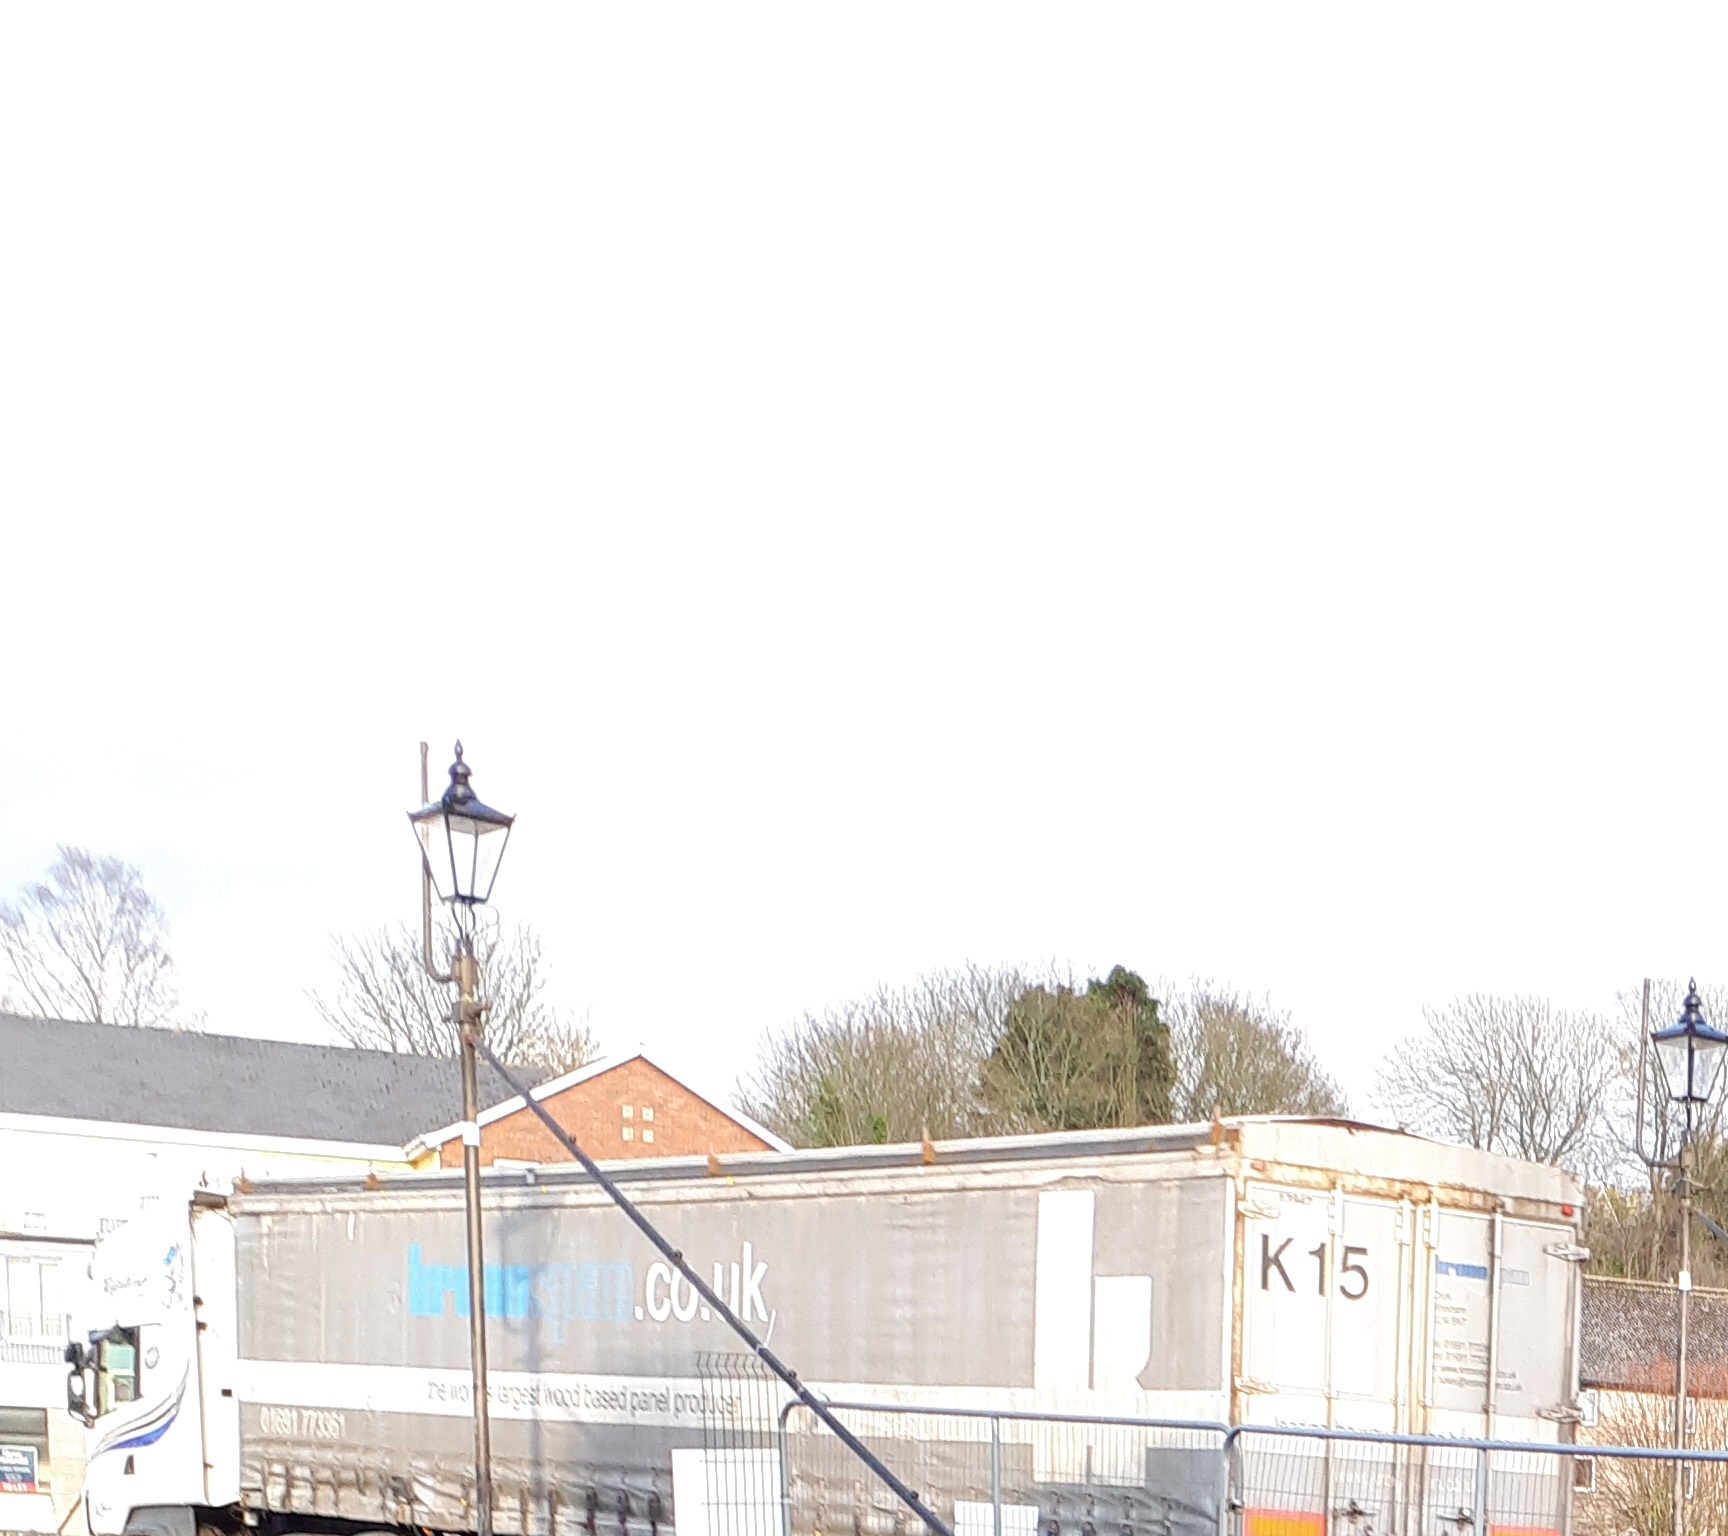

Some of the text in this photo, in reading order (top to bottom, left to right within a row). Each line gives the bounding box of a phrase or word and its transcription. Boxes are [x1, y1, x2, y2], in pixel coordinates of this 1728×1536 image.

[543, 1383, 580, 1408] wood
[584, 1383, 627, 1411] based
[630, 1385, 670, 1418] panel
